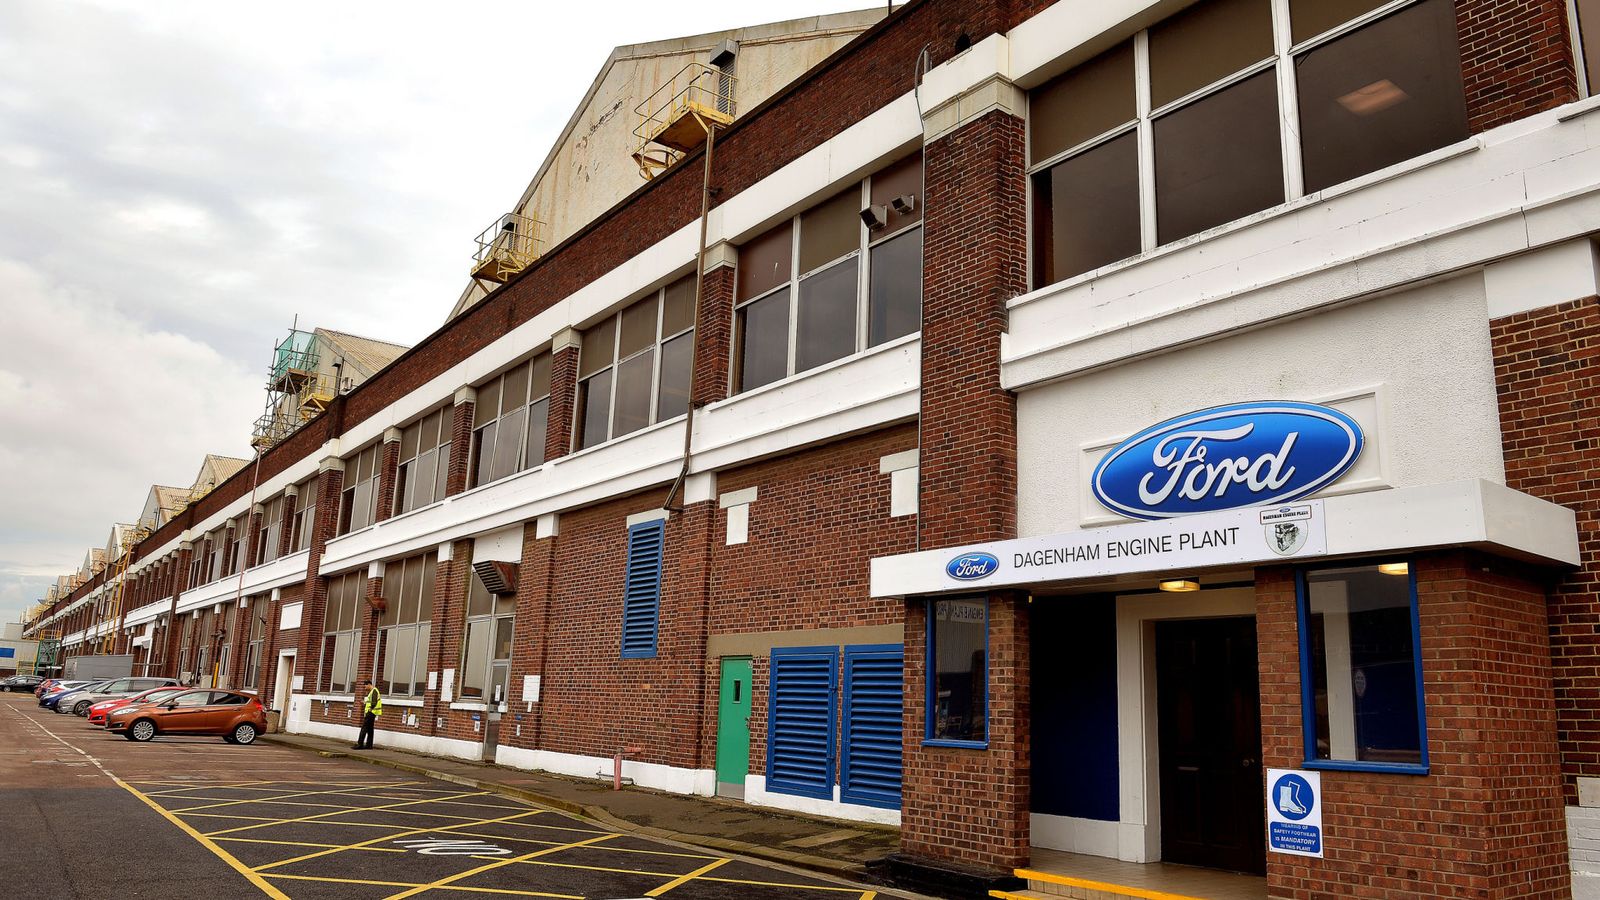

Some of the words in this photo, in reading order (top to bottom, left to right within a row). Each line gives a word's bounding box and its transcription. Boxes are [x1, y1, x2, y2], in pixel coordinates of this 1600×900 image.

[1138, 422, 1299, 506] Ford
[1013, 545, 1101, 568] DAGENHAM
[1106, 535, 1172, 559] ENGINE
[1178, 527, 1240, 549] PLANT
[955, 556, 988, 577] Ford
[392, 839, 513, 856] NO
[1281, 836, 1316, 845] MANDATORY
